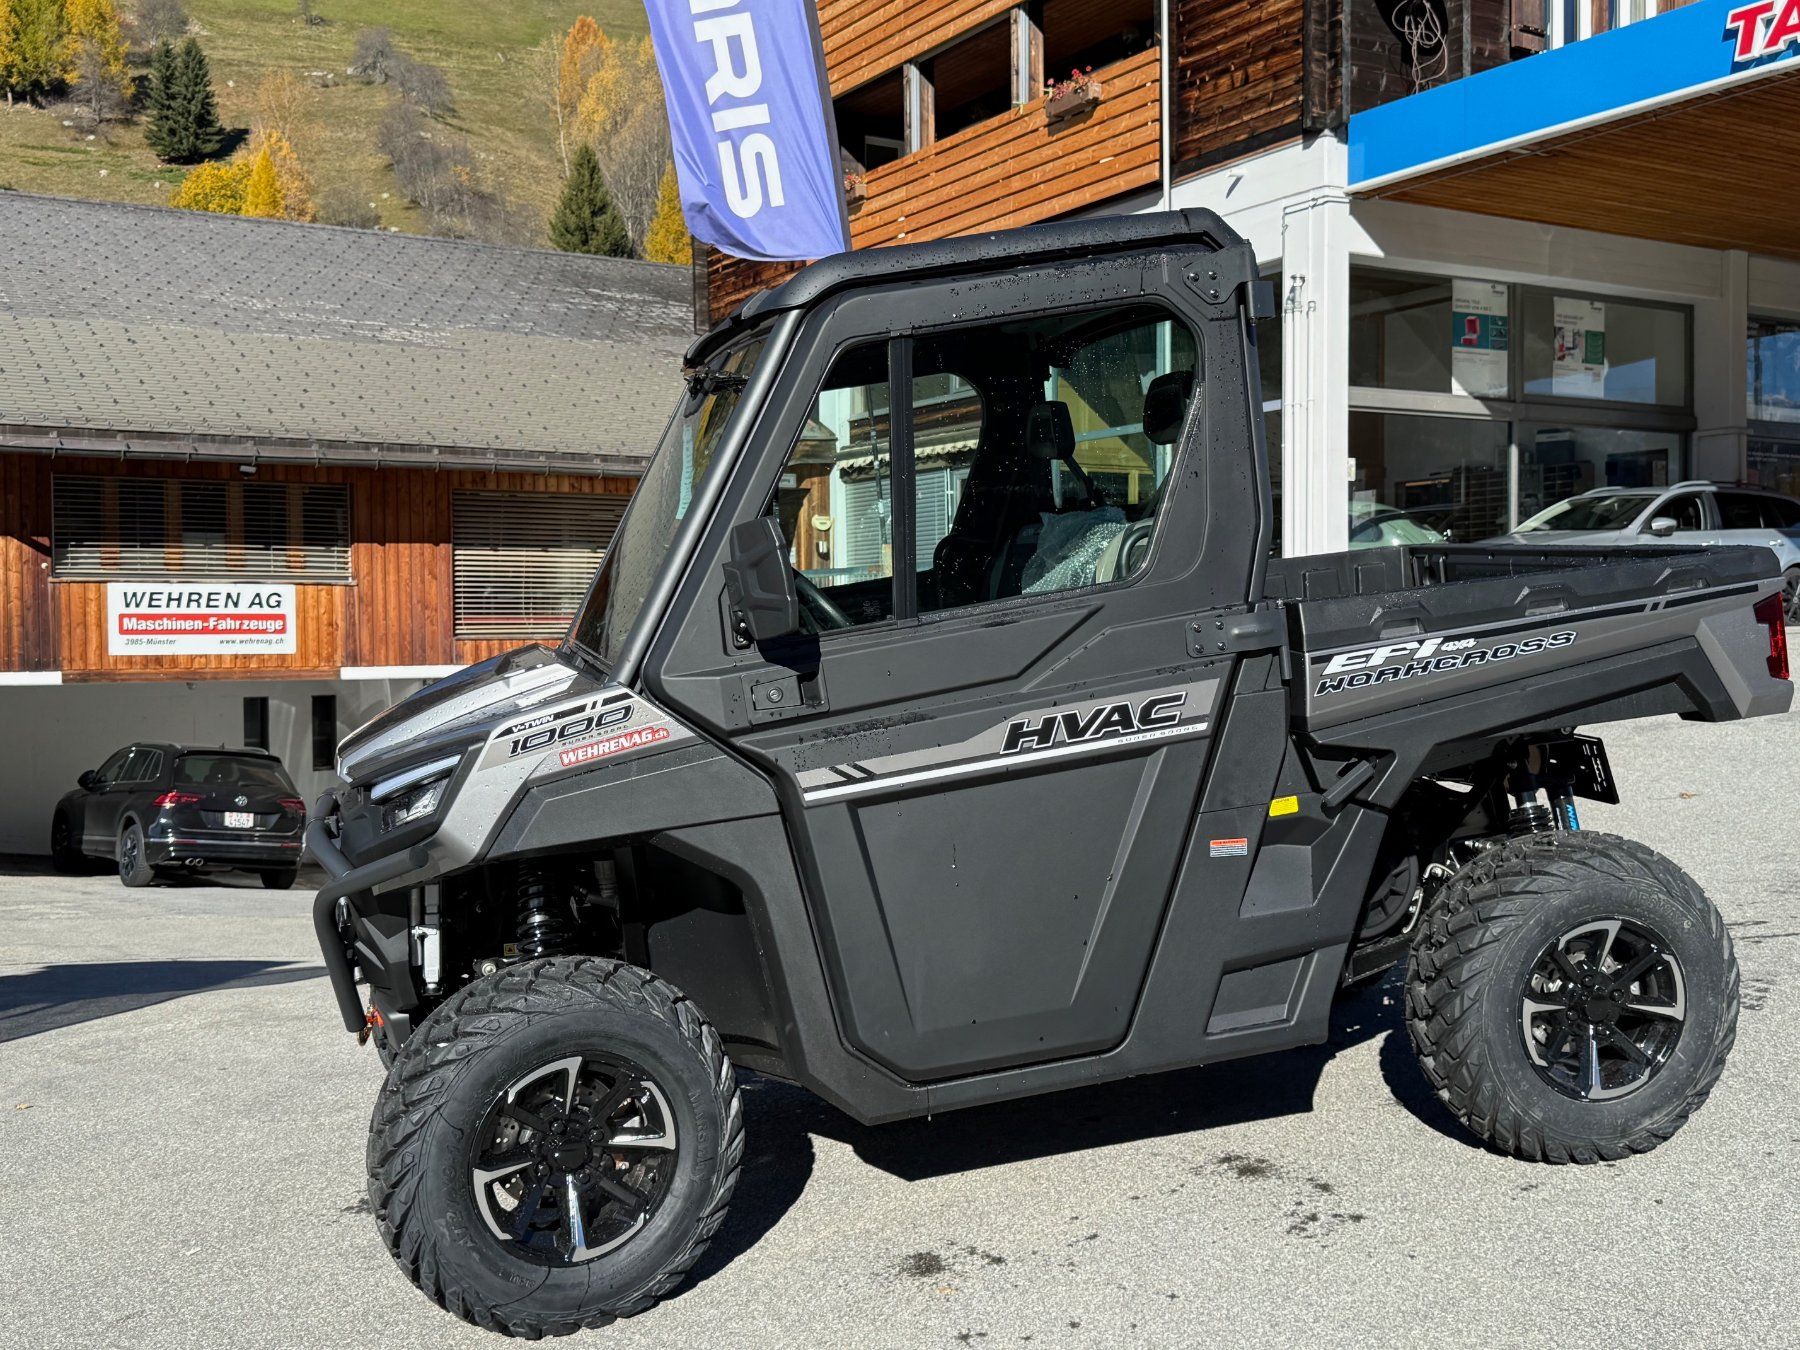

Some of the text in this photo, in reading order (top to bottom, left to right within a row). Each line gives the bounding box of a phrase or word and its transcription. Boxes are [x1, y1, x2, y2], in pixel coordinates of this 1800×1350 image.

[689, 0, 785, 219] RIS
[123, 591, 283, 609] WEHREN AG
[123, 616, 284, 632] Maschinen-Fahrzeuge
[124, 637, 284, 646] 3985-Münster www.wehrenag.ch
[1314, 631, 1578, 697] WORKCROSS
[1321, 637, 1444, 676] EFI
[508, 702, 635, 758] 1000
[511, 714, 555, 733] V-TWIN
[1000, 691, 1187, 755] HVAC
[561, 729, 669, 766] WEHRENAG.ch
